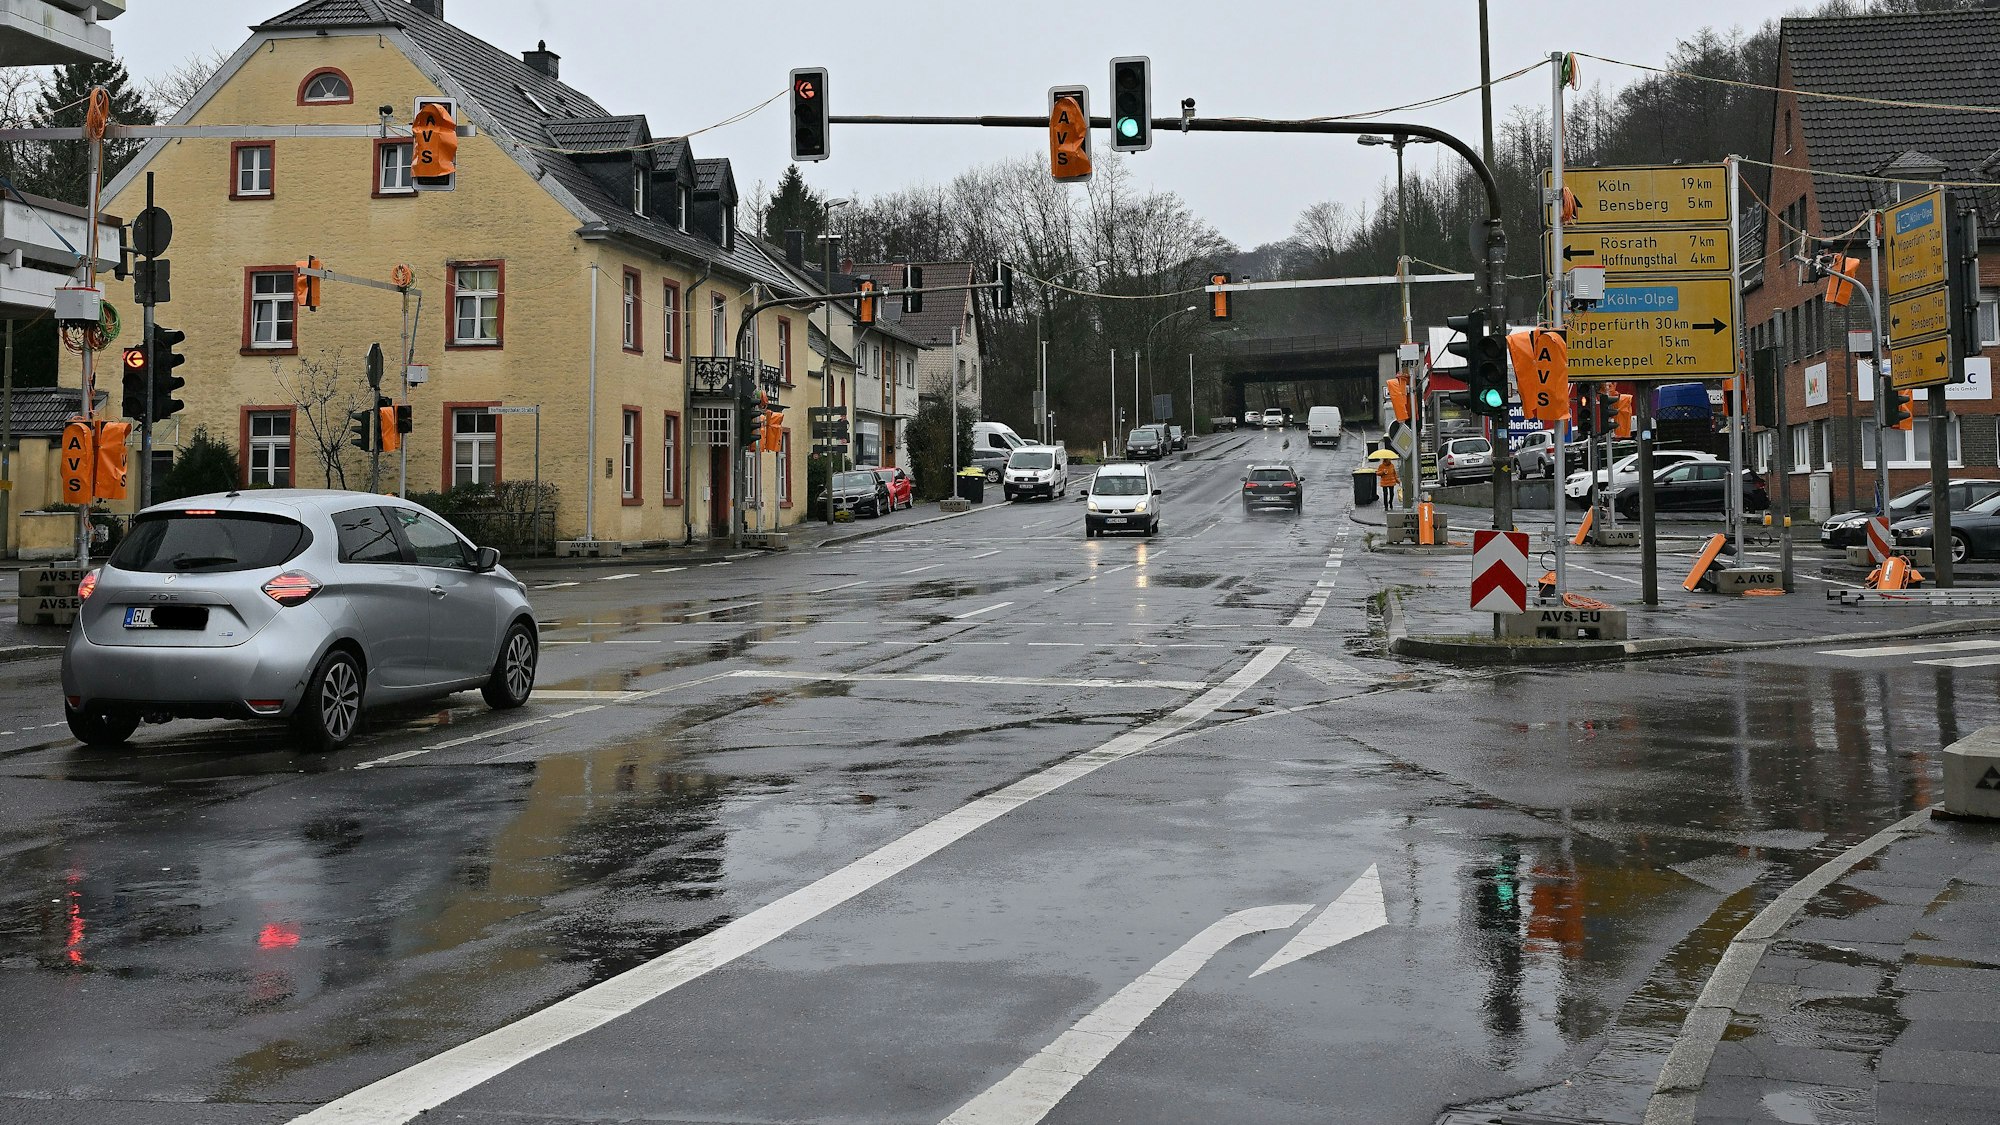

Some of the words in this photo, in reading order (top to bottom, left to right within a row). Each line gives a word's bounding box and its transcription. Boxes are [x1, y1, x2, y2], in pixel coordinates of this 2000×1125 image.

[1057, 111, 1070, 165] AVS
[1598, 179, 1630, 192] Köln
[1681, 178, 1694, 190] 19
[1697, 177, 1712, 189] km
[1599, 199, 1669, 212] Bensberg
[1688, 197, 1695, 208] 5
[1698, 197, 1713, 208] km
[1601, 236, 1657, 249] Rösrath
[1689, 235, 1697, 247] 7
[1699, 235, 1715, 247] km
[1601, 253, 1678, 268] Hoffnungsthal
[1690, 253, 1699, 264] 4
[1700, 252, 1716, 264] km
[1607, 293, 1674, 307] Köln-Olpe
[1655, 318, 1672, 330] 30
[1674, 318, 1689, 329] km
[1659, 336, 1673, 347] 15
[1675, 336, 1690, 347] km
[1568, 354, 1654, 369] mmekeppel
[1666, 353, 1674, 365] 2
[1676, 353, 1697, 365] km
[1537, 348, 1551, 406] AVS
[68, 437, 81, 491] AVS
[1749, 575, 1775, 584] AVS
[39, 599, 80, 609] AVS.E
[149, 593, 179, 601] ZOE
[133, 609, 147, 623] GL
[1541, 611, 1600, 622] AVS.EU
